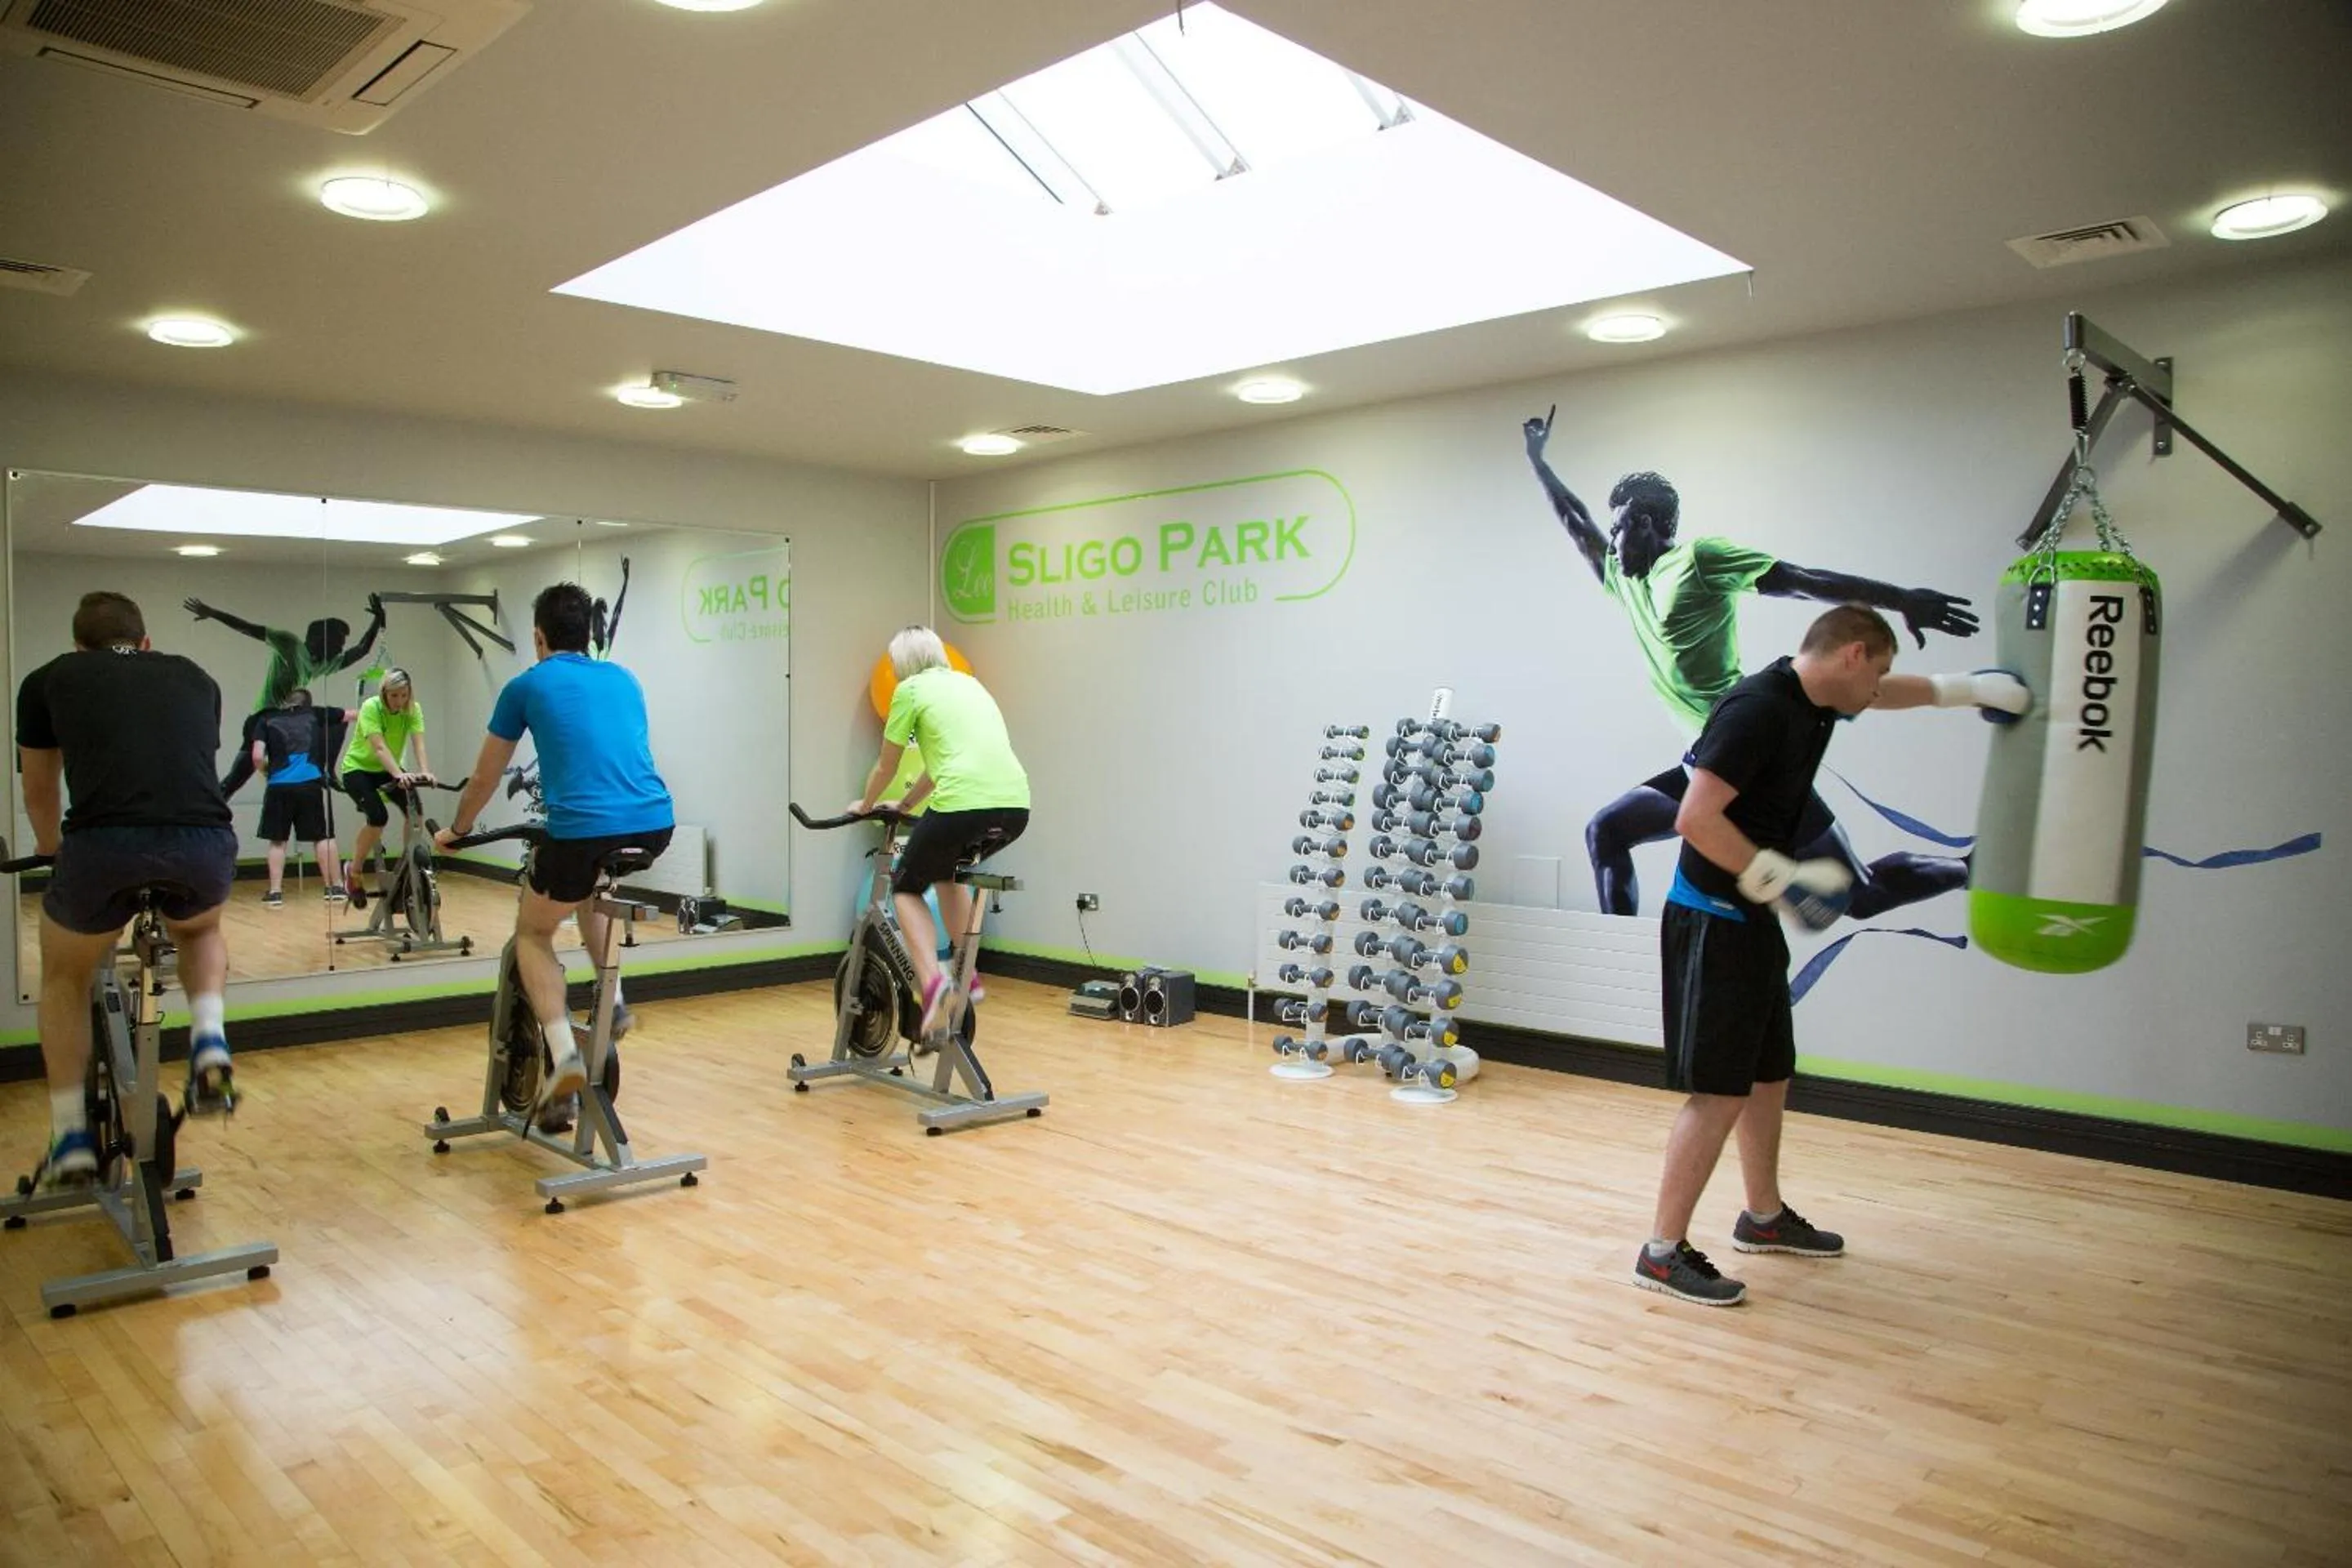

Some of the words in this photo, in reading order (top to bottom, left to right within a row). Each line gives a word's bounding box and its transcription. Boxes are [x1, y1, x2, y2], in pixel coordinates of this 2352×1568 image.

[1009, 537, 1143, 586] SLIGO
[1160, 515, 1311, 572] PARK
[1008, 589, 1071, 621] Health
[1082, 590, 1097, 616] &
[1108, 586, 1191, 613] Leisure
[1203, 577, 1258, 606] Club
[2078, 595, 2123, 753] Reebok
[879, 922, 915, 982] SPINNING
